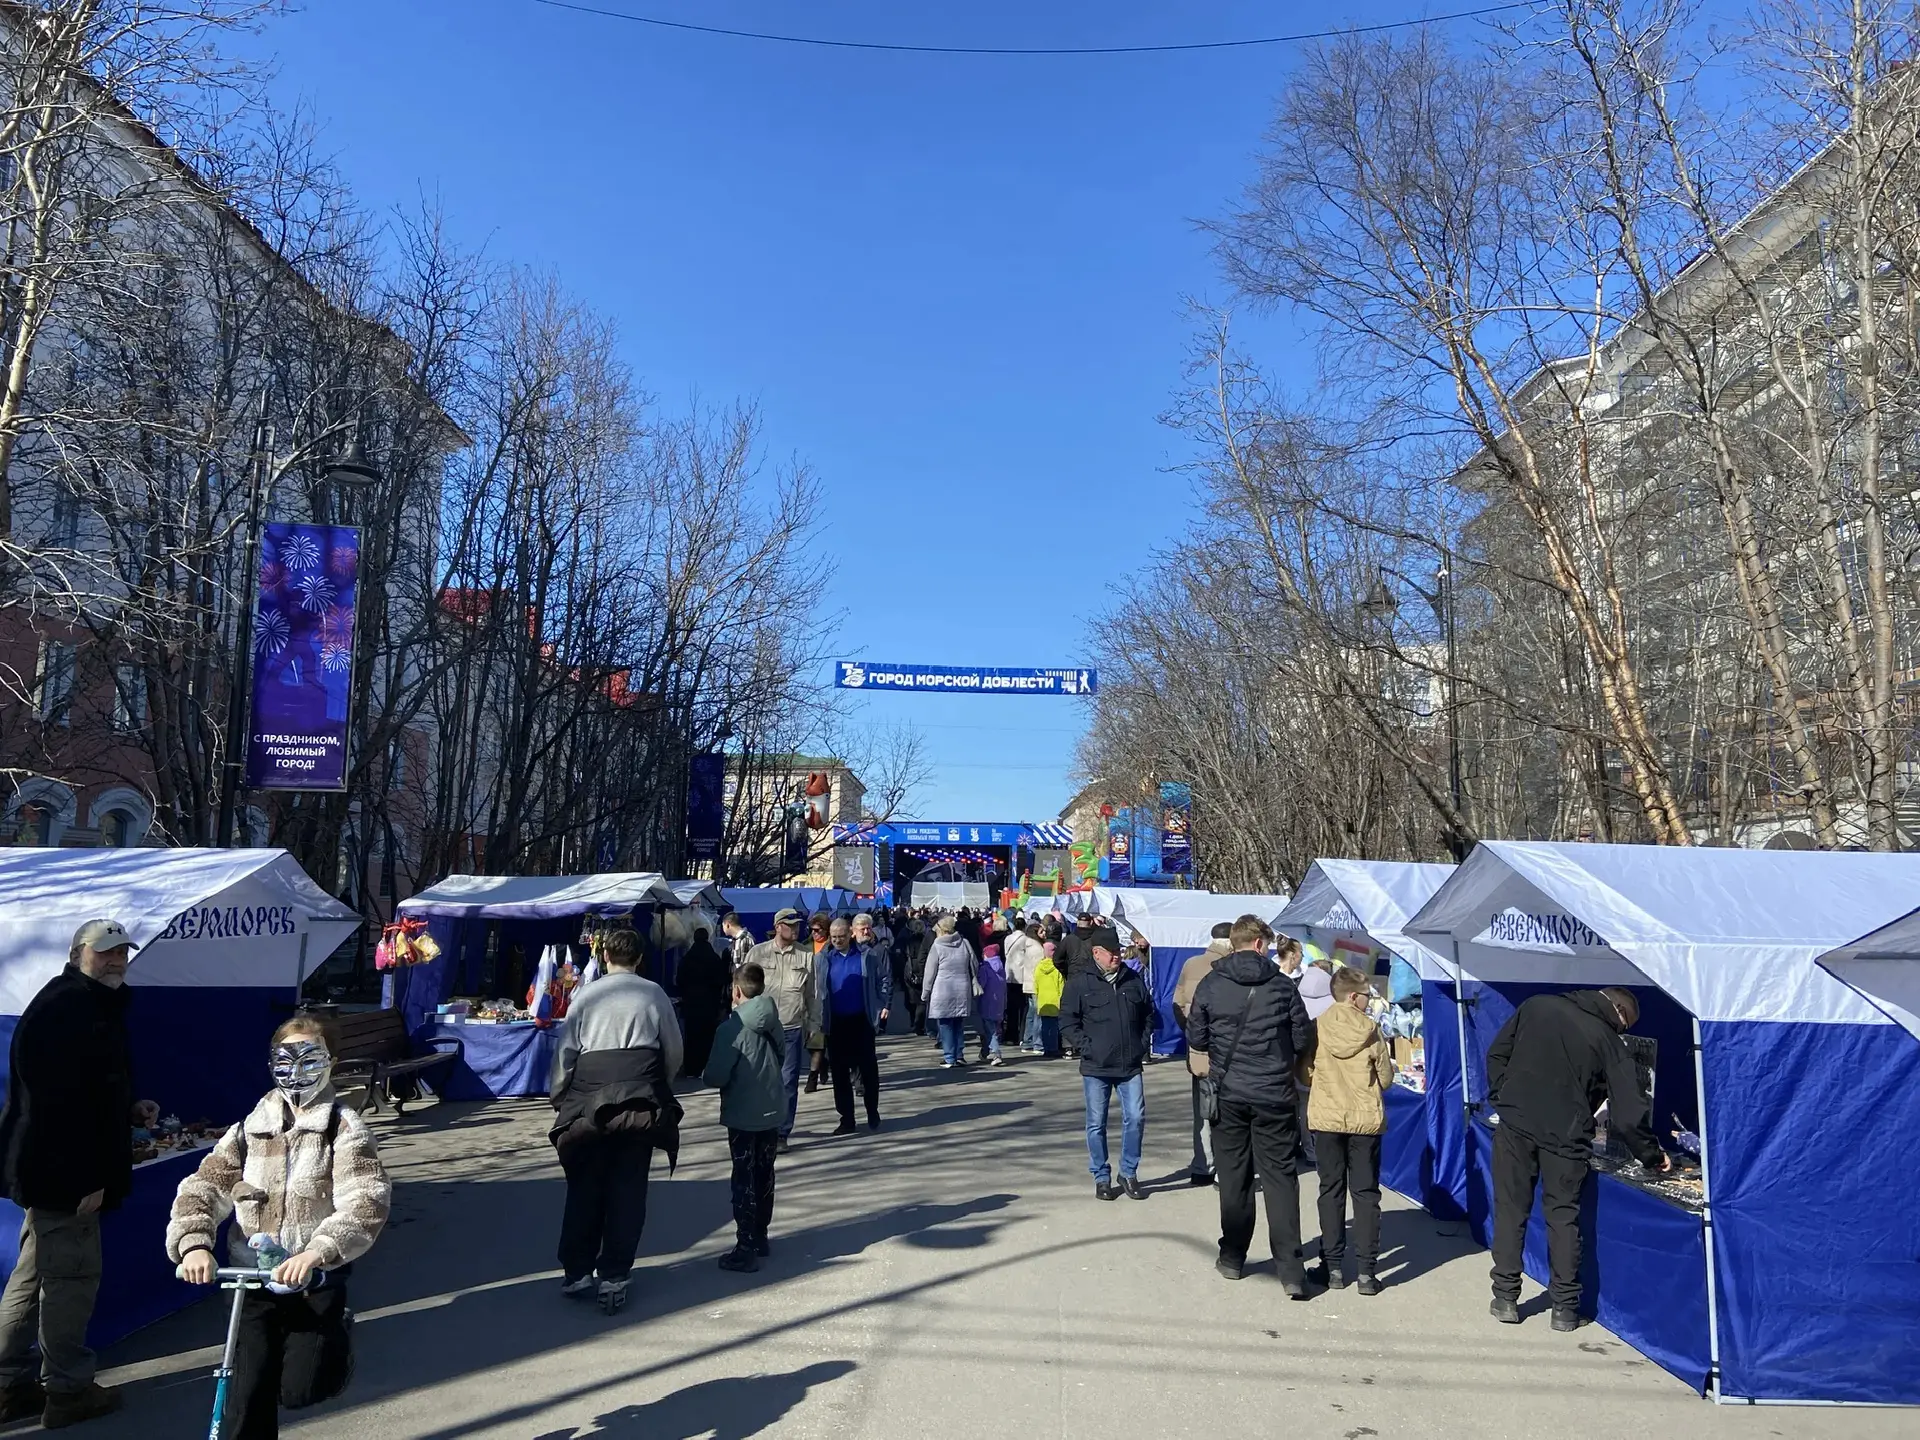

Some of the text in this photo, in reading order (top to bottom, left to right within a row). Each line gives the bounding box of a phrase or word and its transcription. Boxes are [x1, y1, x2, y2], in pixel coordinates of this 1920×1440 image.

[869, 672, 1054, 689] ГОРОД МОРСКОЙ ДОБЛЕСТИ
[253, 734, 340, 747] С ПРАЗДНИКОМ,
[266, 746, 326, 757] ЛЮБИМЫЙ
[275, 759, 315, 770] ГОРОД!
